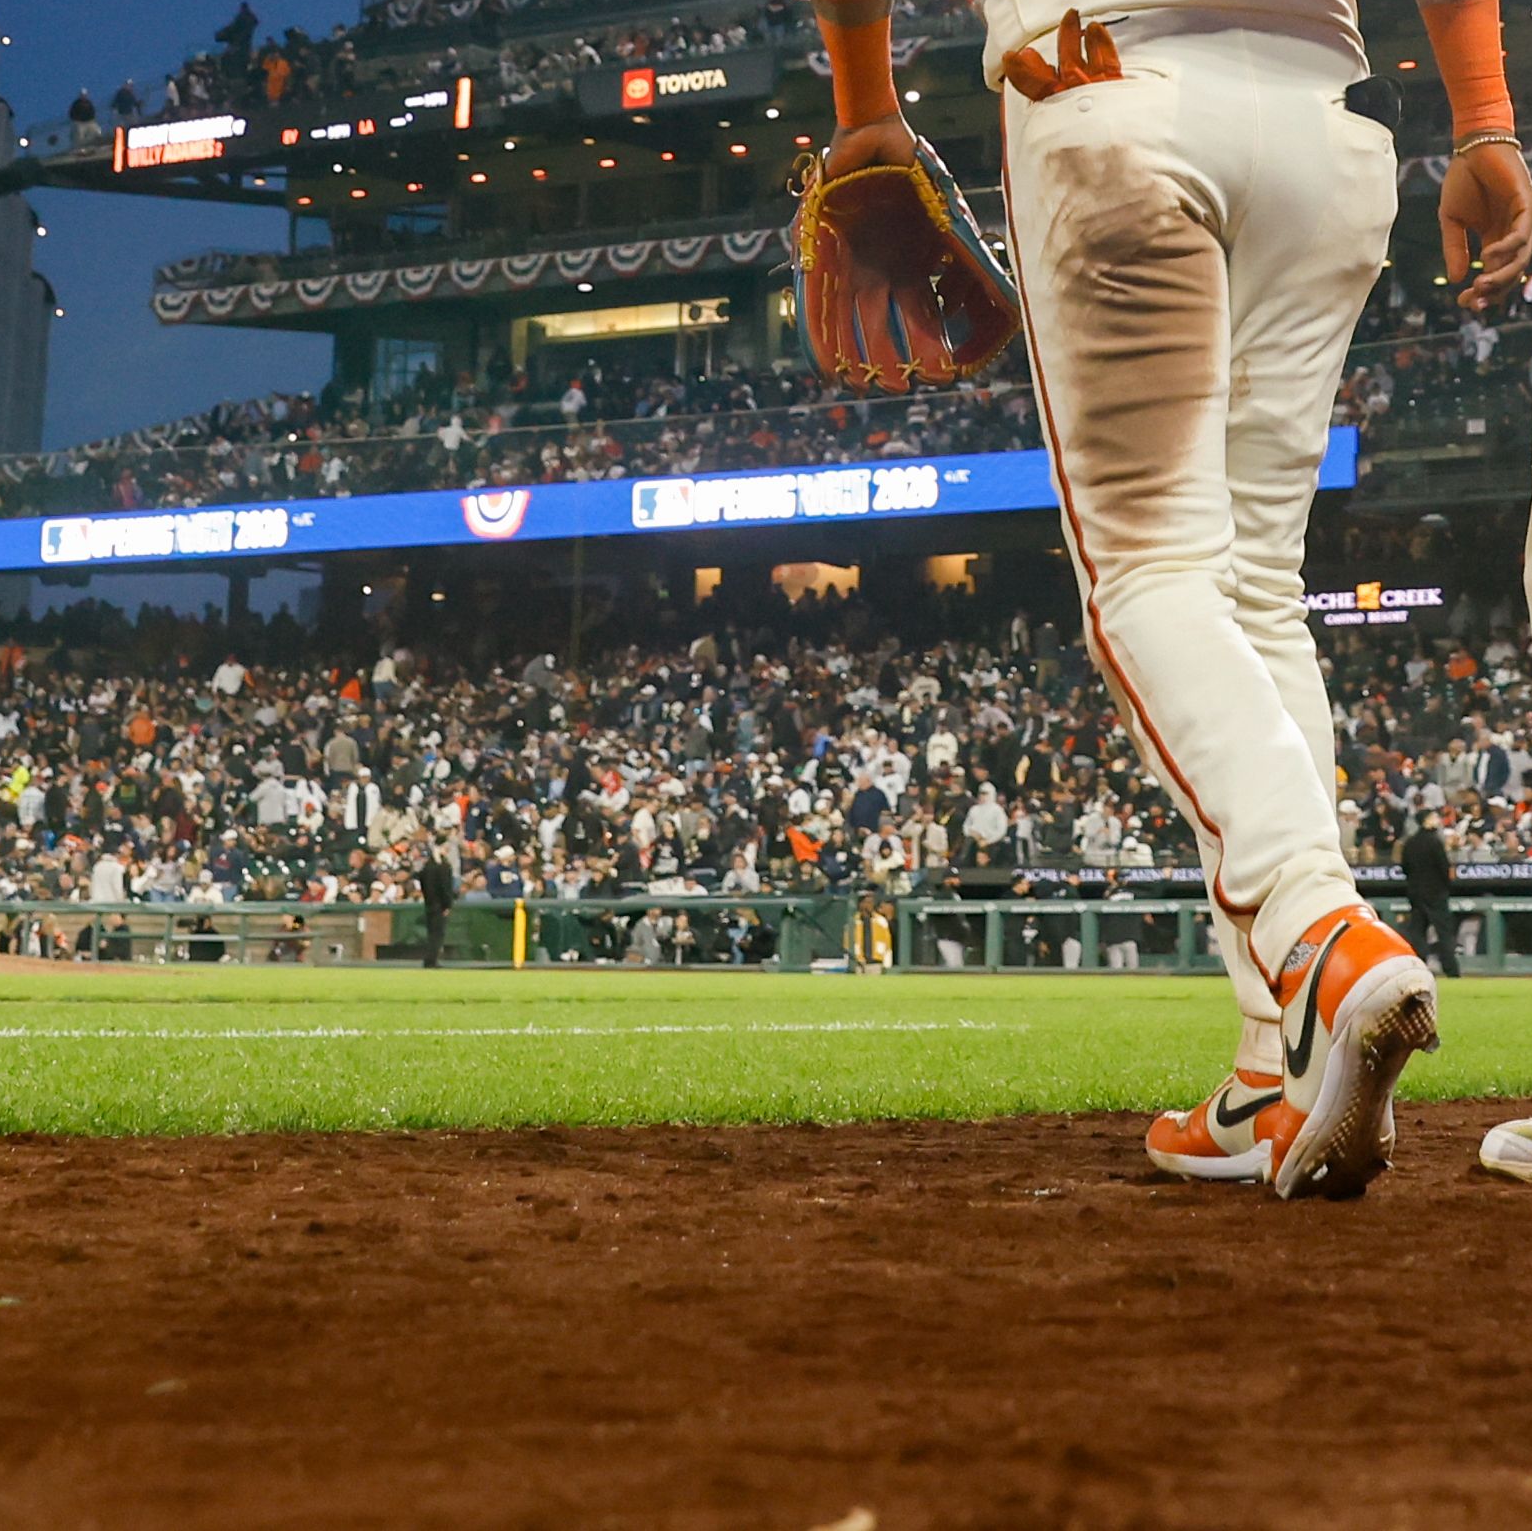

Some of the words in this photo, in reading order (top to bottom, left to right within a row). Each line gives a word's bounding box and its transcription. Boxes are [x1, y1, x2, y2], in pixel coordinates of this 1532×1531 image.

[656, 68, 727, 95] TOYOTA
[1300, 591, 1357, 611] ACHE
[1380, 587, 1444, 608] CREEK
[1456, 863, 1512, 879] CASINO
